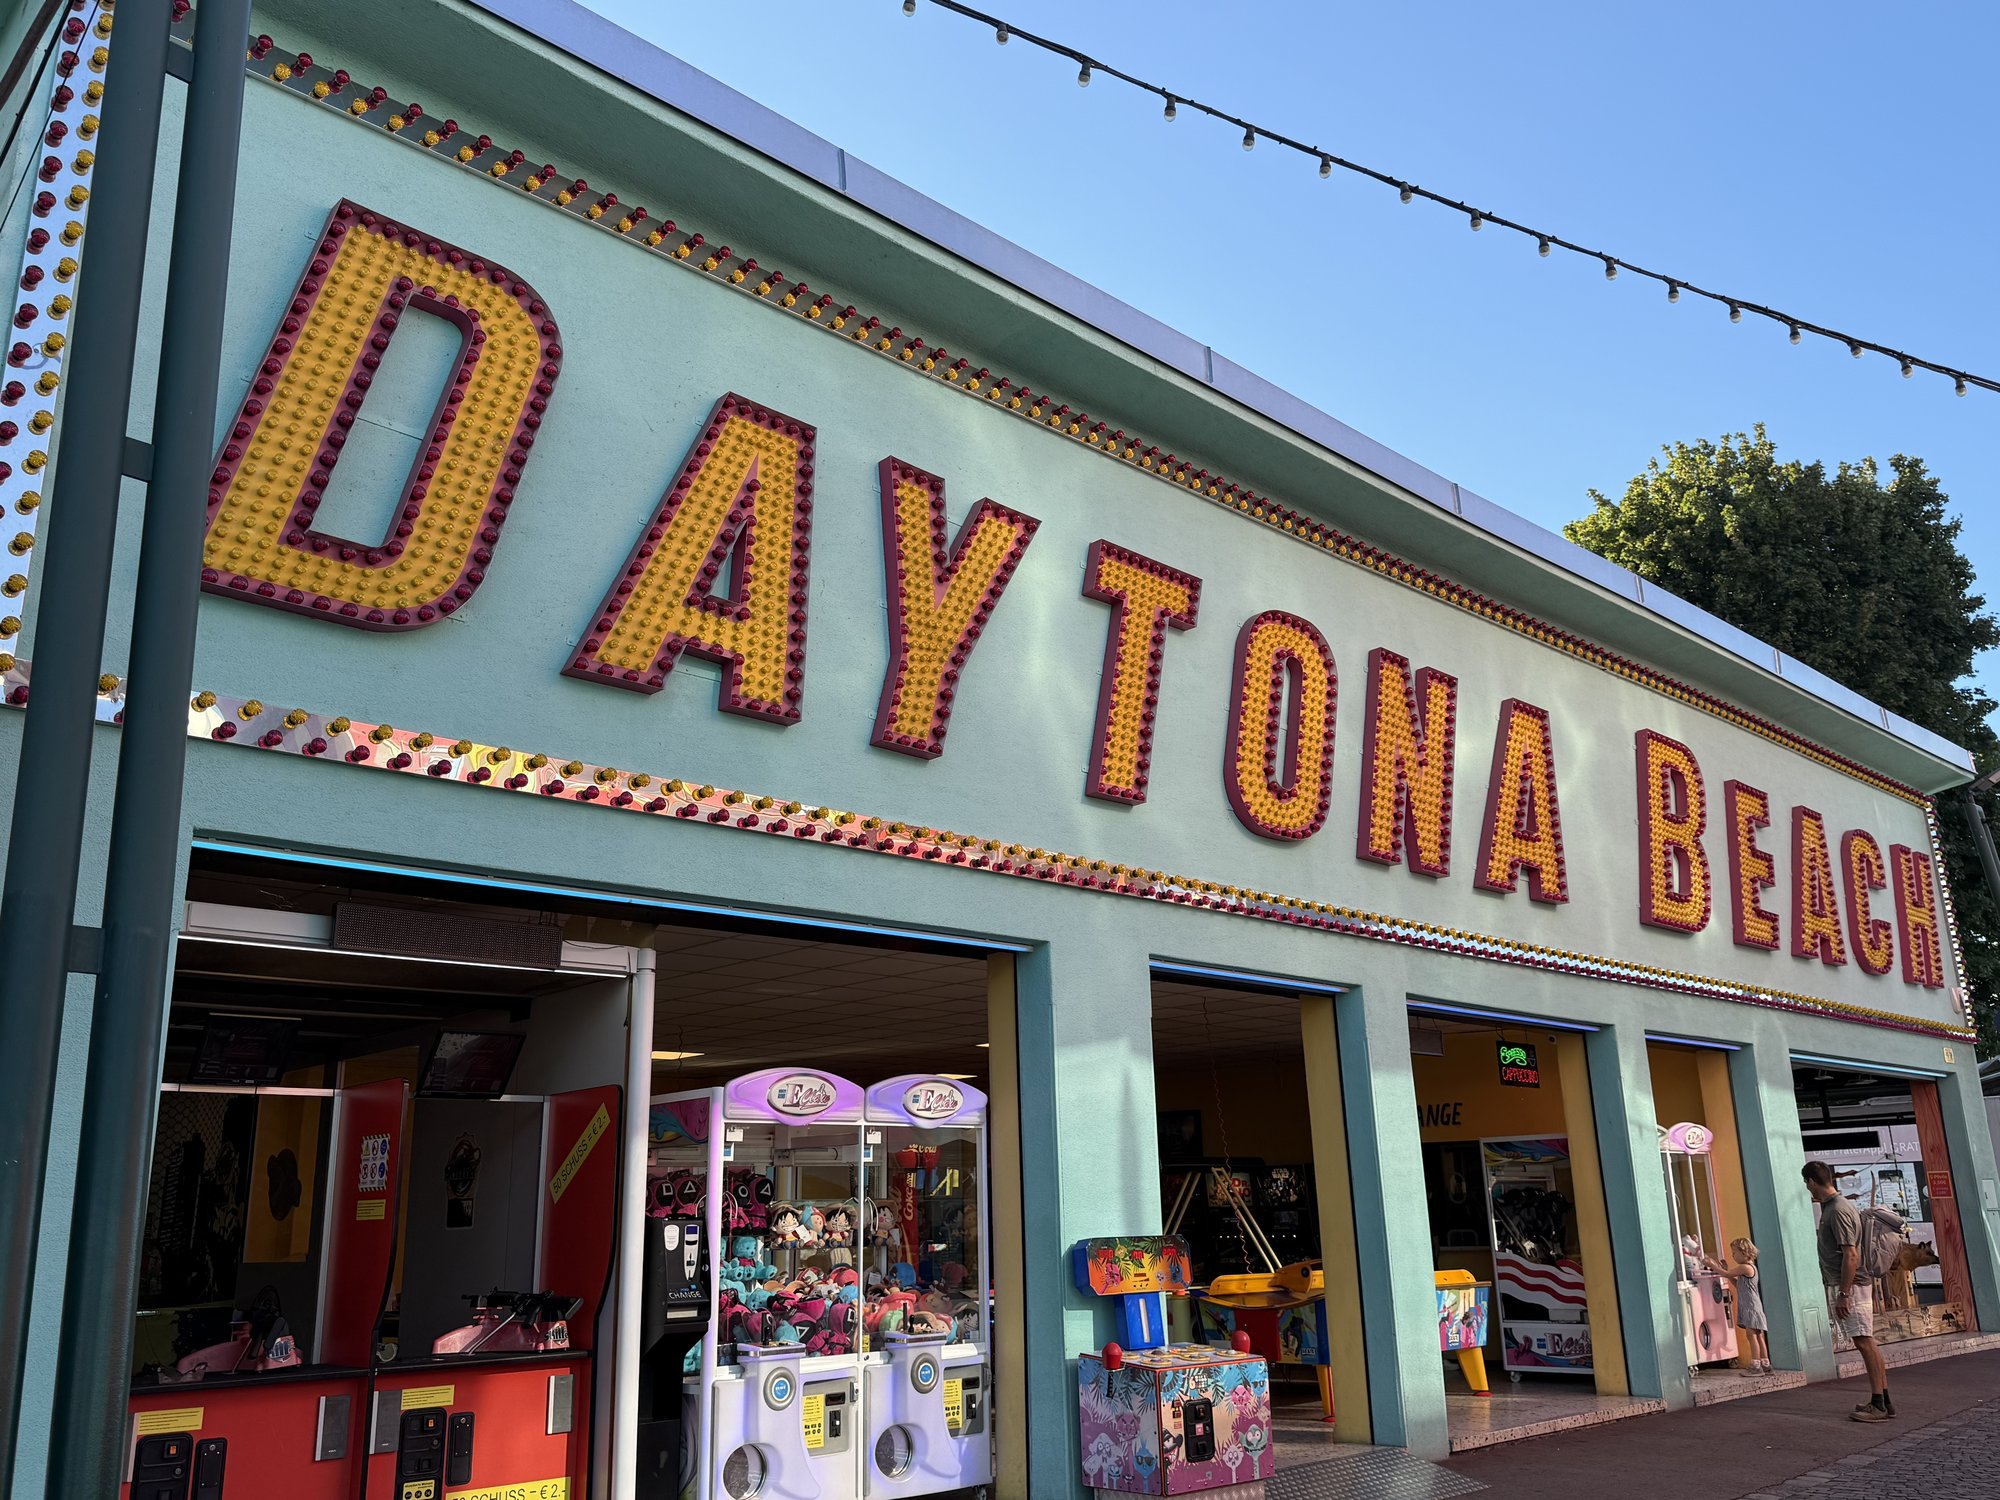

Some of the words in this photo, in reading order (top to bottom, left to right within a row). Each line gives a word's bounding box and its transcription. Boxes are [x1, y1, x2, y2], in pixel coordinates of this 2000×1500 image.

[200, 197, 1569, 905] DAYTONA
[1635, 728, 1945, 990] BEACH
[552, 1177, 562, 1194] 50
[561, 1139, 588, 1182] SCHUSS
[669, 1290, 702, 1300] CHANGE
